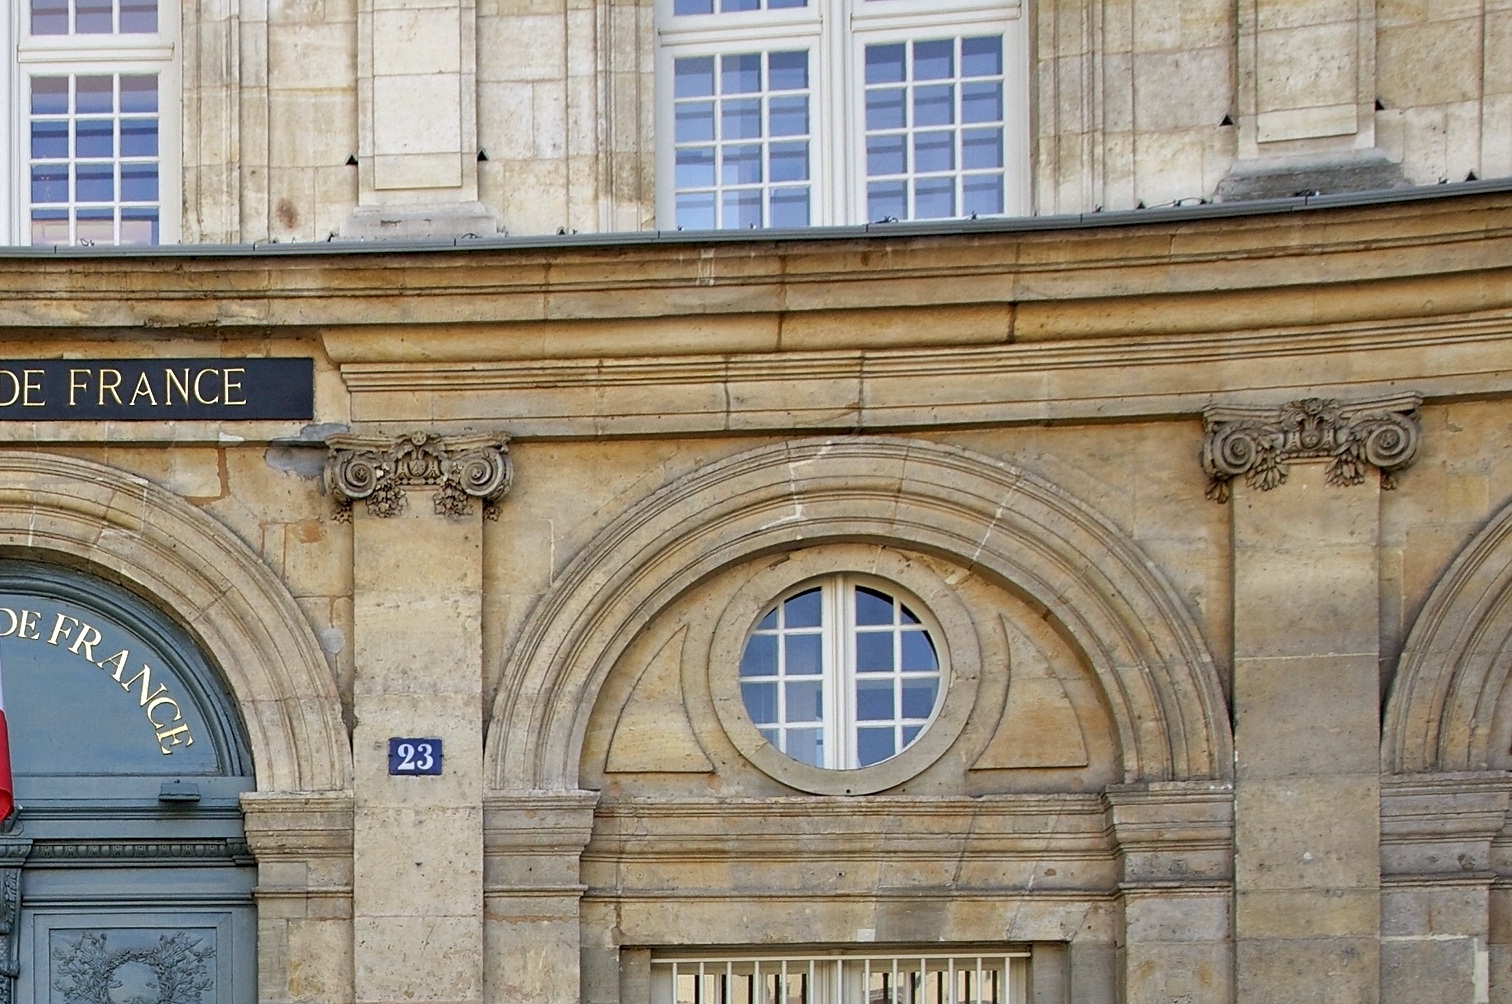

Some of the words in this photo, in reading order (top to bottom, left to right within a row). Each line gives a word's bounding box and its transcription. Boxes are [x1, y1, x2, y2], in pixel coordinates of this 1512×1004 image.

[69, 367, 248, 407] FRANCE
[48, 613, 194, 756] FRANCE
[396, 743, 434, 770] 23
